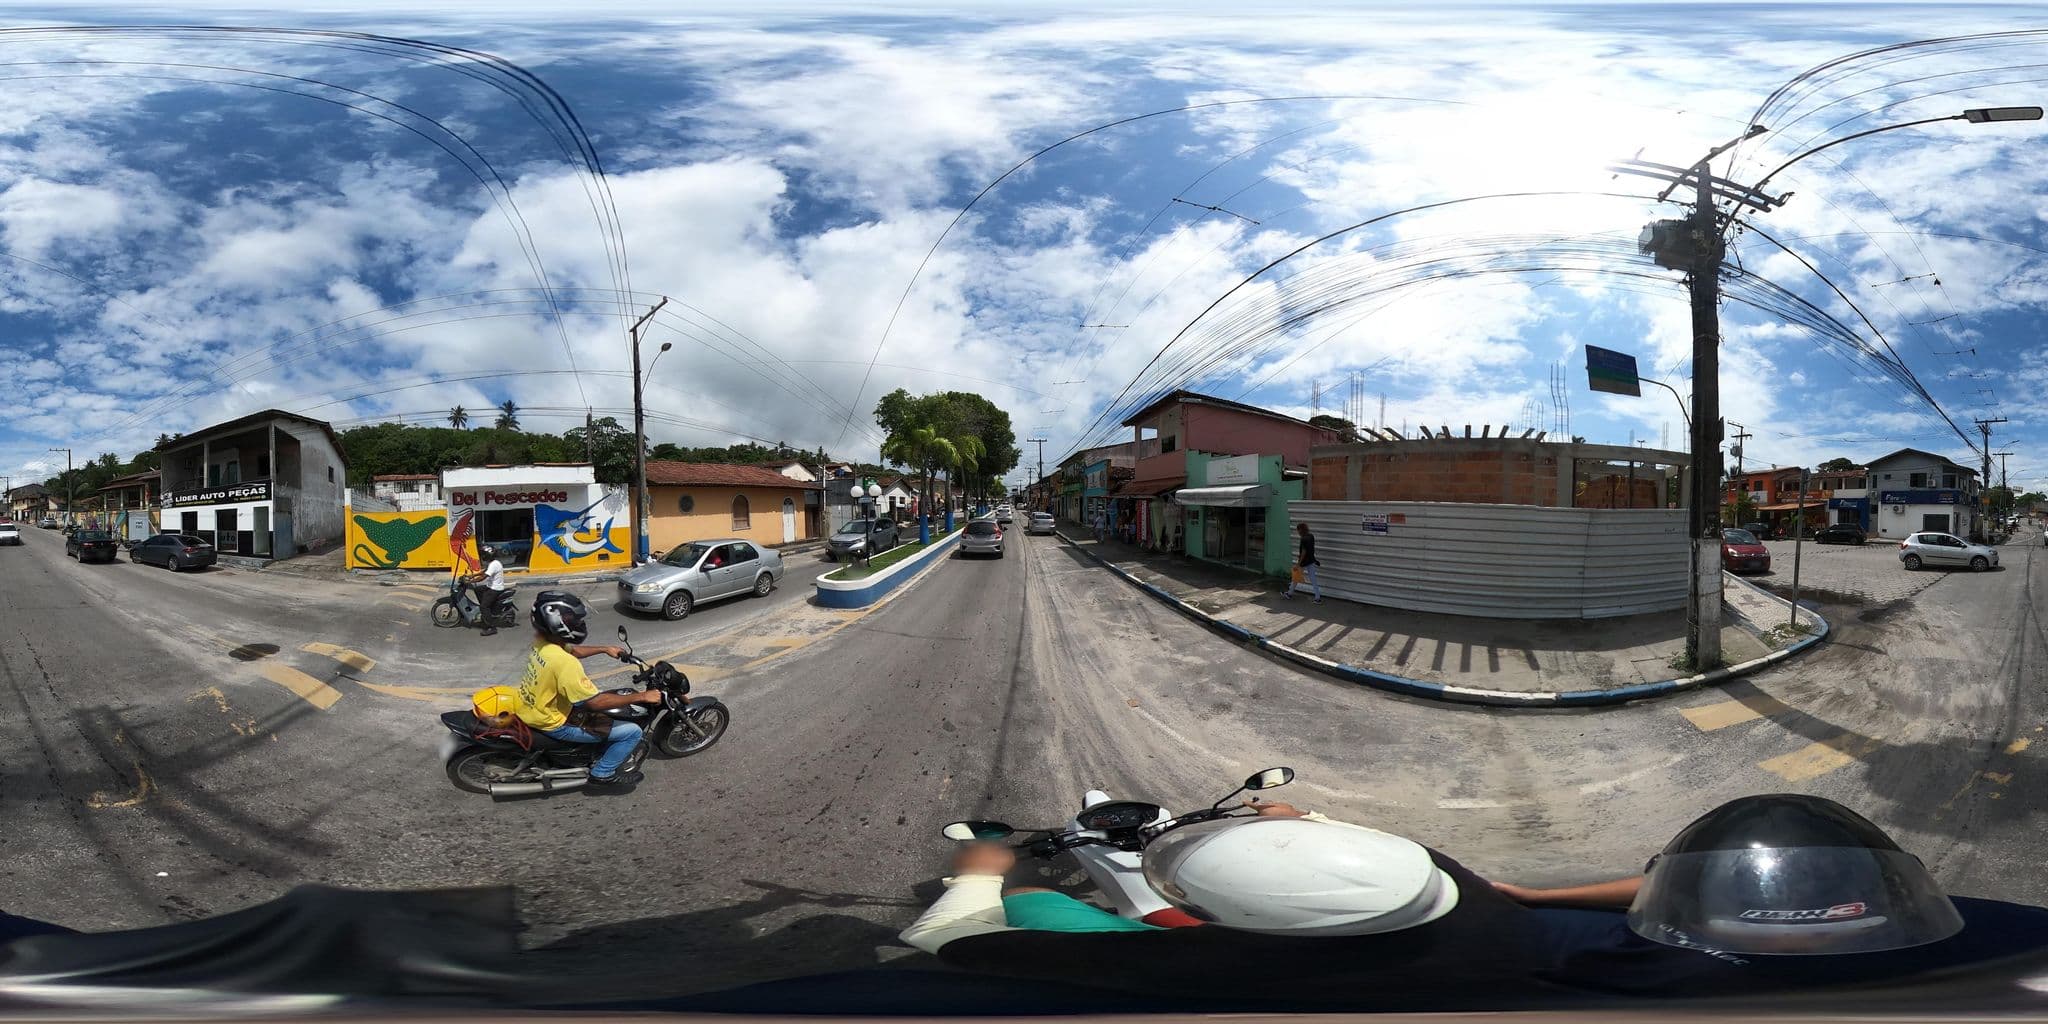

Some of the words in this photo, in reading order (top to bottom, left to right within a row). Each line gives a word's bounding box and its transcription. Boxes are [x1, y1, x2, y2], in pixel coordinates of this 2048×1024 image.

[175, 494, 198, 502] LÍDER
[200, 491, 226, 500] AUTO
[228, 486, 266, 497] PEÇAS
[452, 491, 479, 505] Del
[485, 489, 568, 504] Pescados
